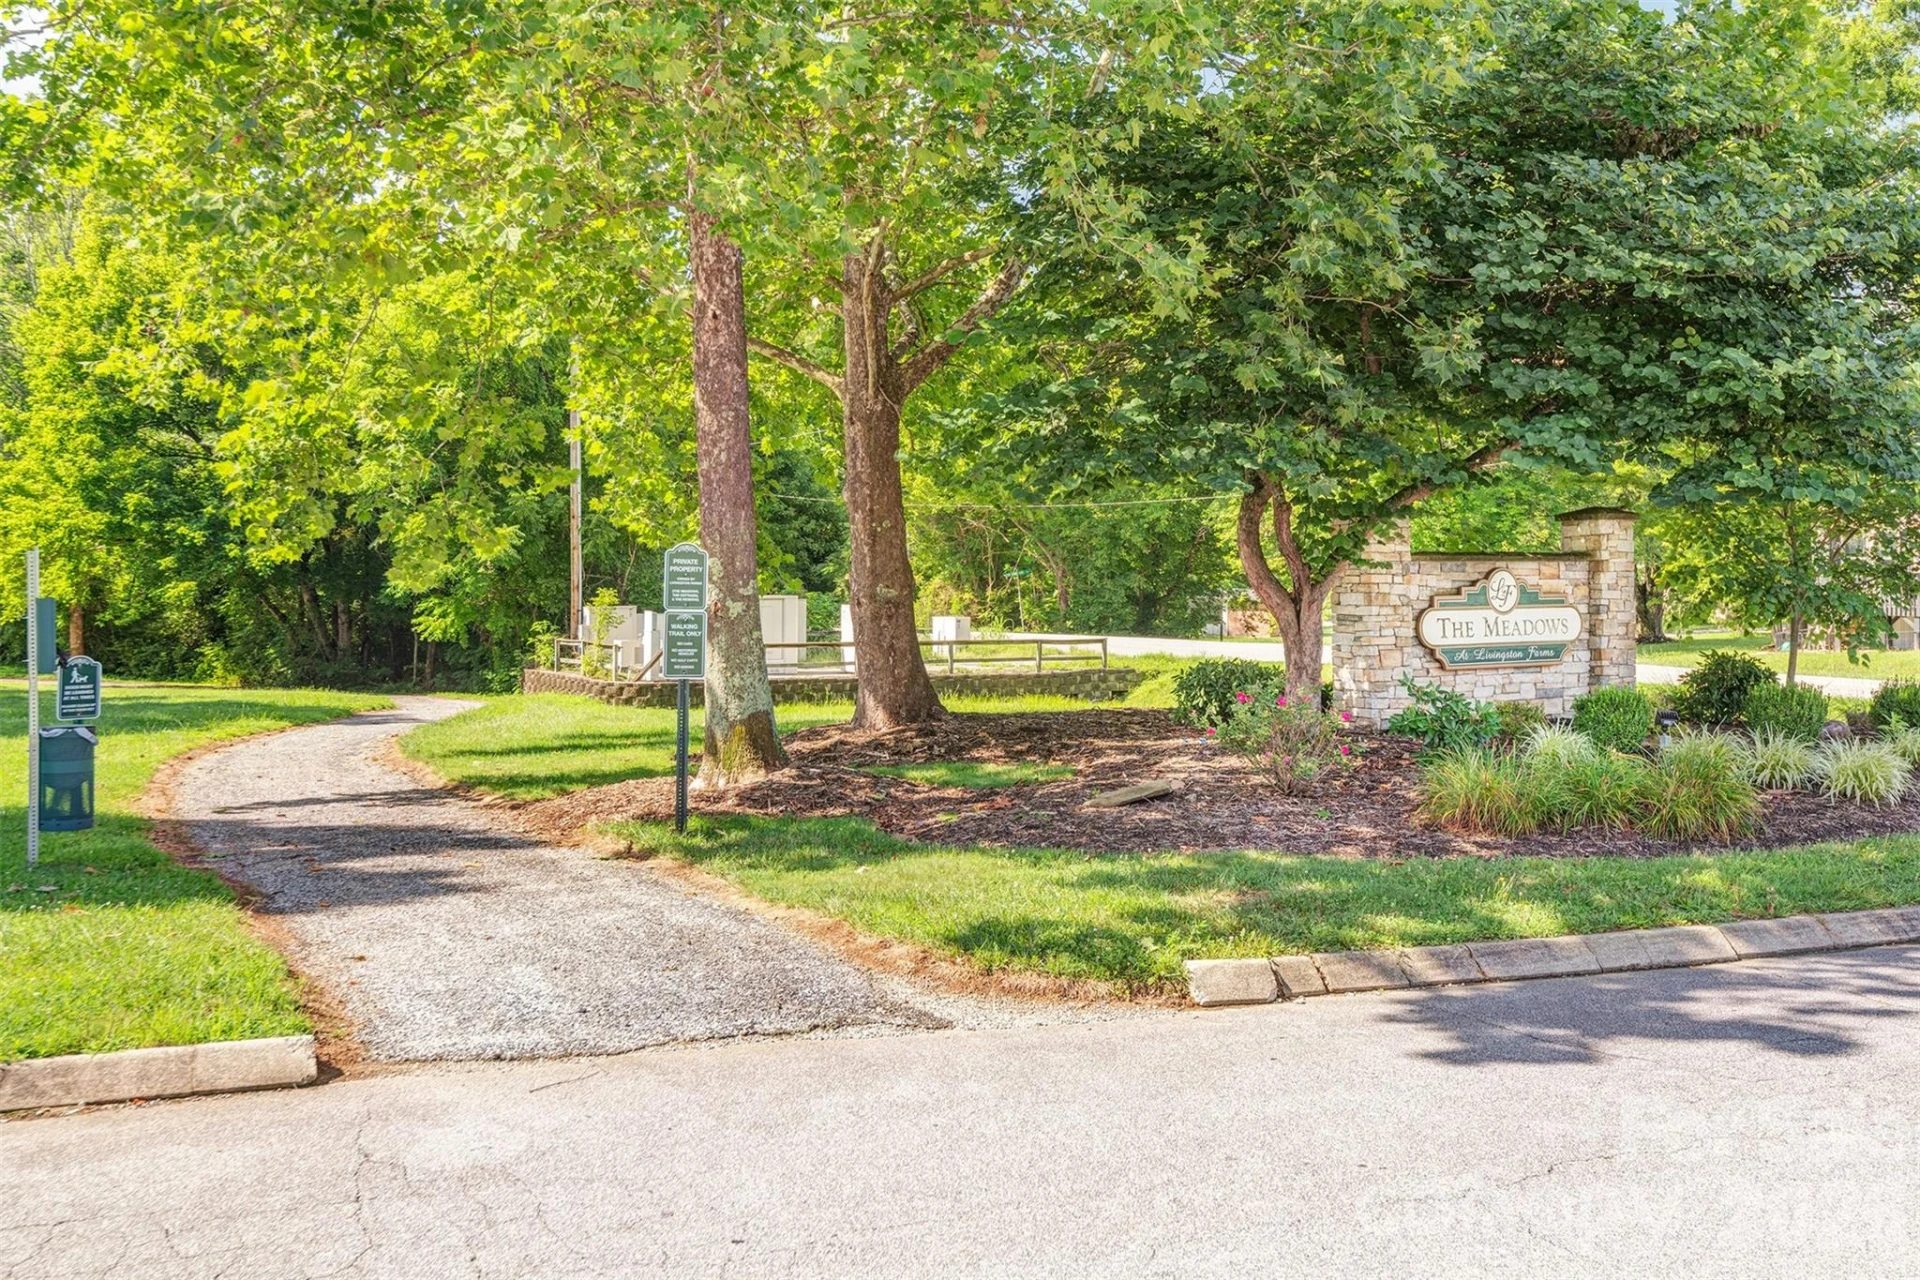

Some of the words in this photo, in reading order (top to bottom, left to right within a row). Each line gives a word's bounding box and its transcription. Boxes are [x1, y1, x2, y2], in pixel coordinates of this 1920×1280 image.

[1436, 617, 1475, 639] THE
[1482, 616, 1569, 639] MEADOWS
[1474, 648, 1524, 662] Livingston
[1526, 646, 1555, 661] Farms
